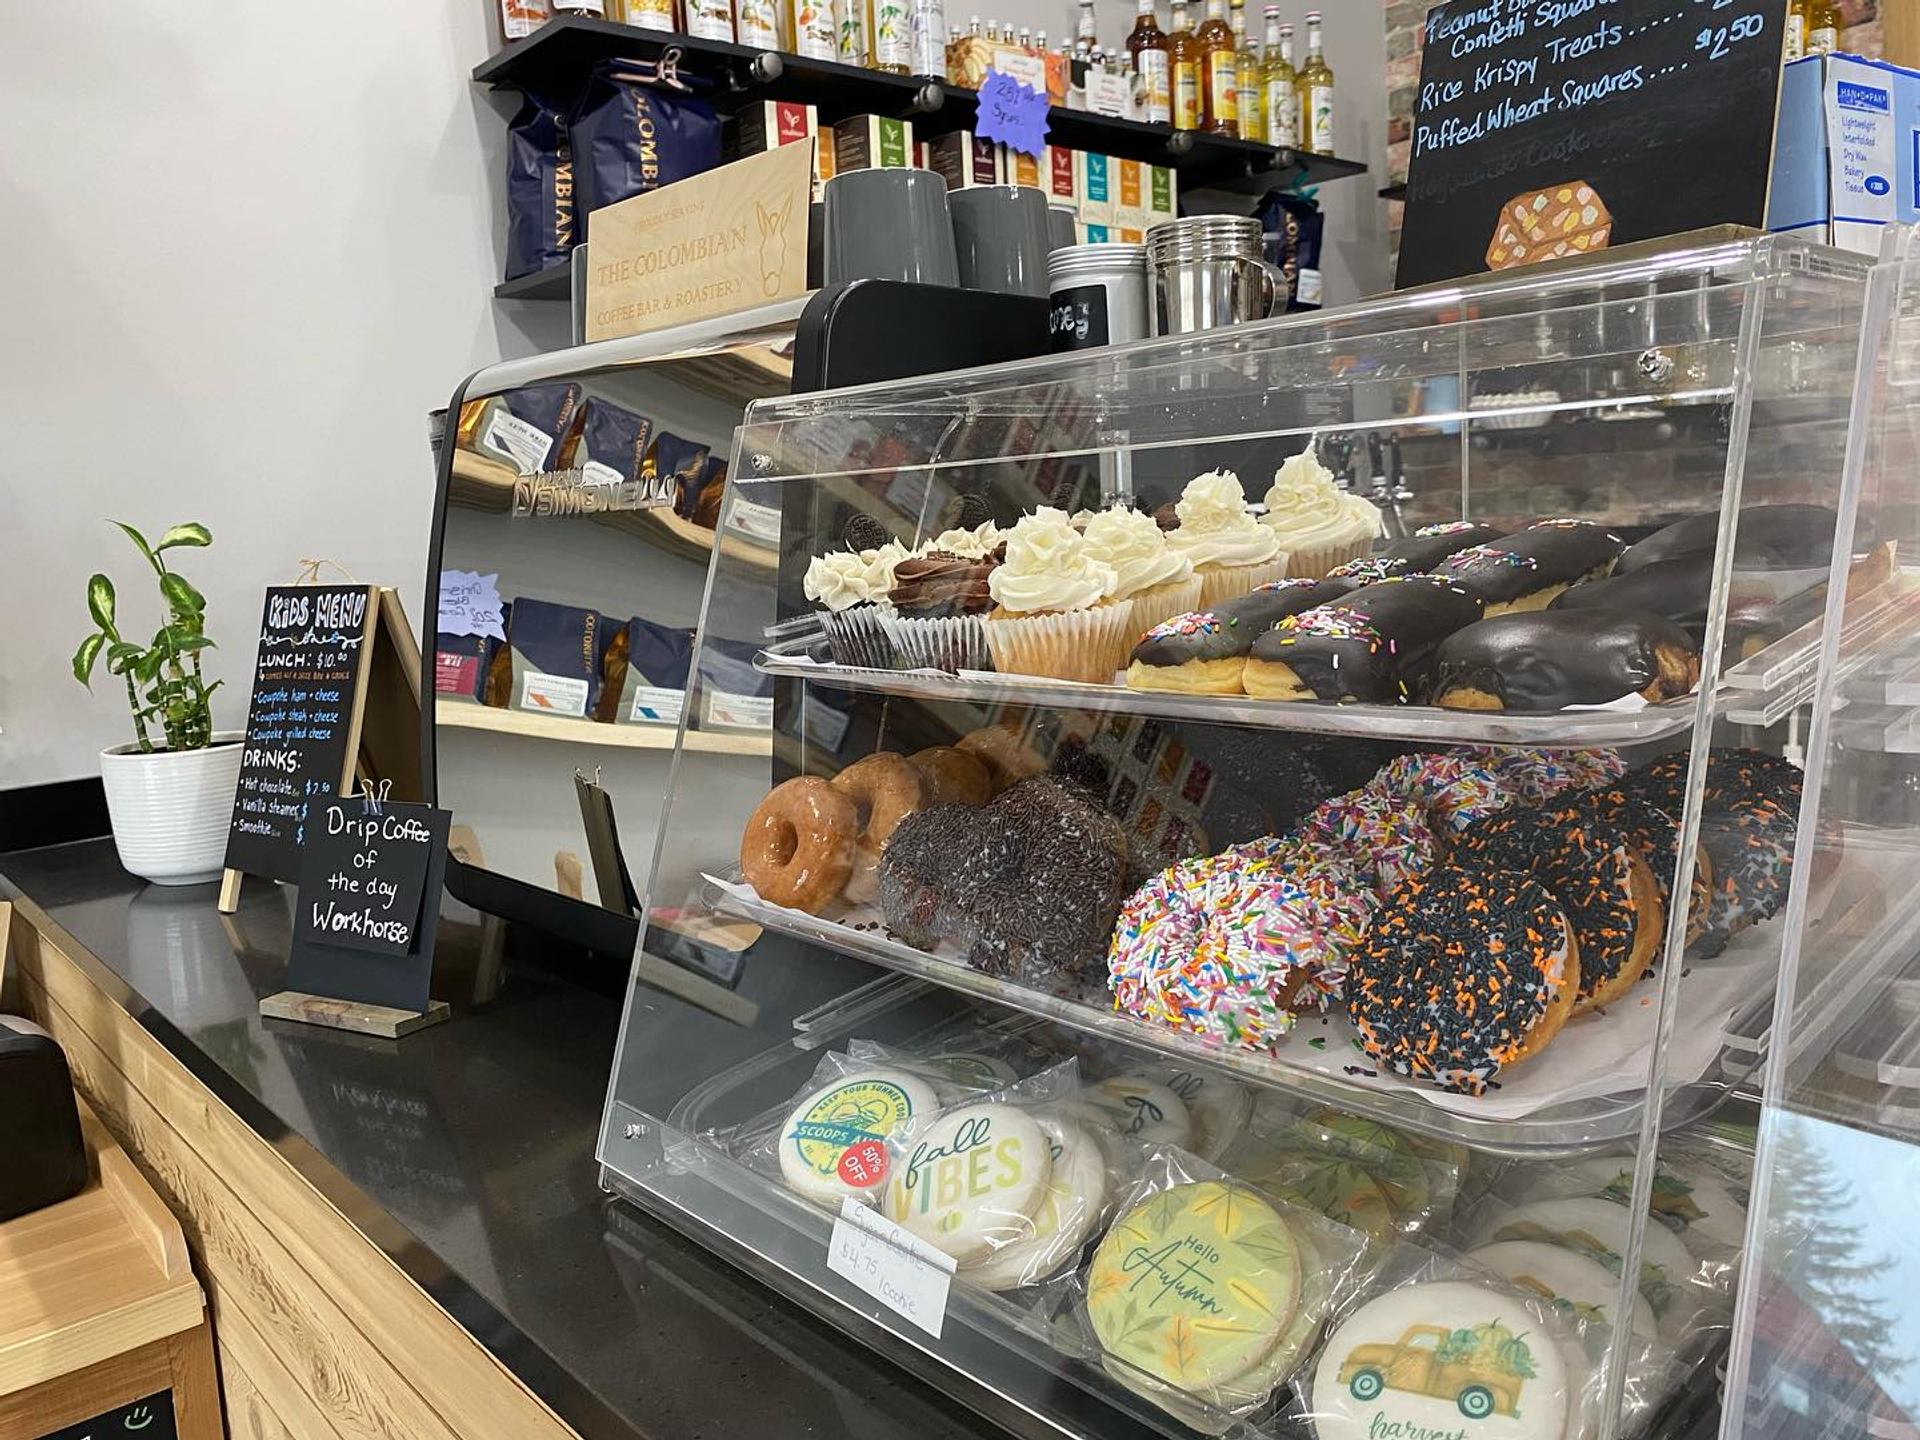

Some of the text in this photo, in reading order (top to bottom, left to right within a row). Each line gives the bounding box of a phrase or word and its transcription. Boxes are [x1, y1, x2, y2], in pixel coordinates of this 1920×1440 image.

[1452, 0, 1617, 58] Confetti Squa
[1420, 80, 1464, 112] Rice
[1473, 56, 1539, 93] Krispy
[1545, 20, 1622, 64] Treats
[1416, 112, 1485, 157] Puffed
[1487, 87, 1555, 130] Wheat
[1558, 66, 1643, 109] Squares
[598, 225, 747, 287] THE COLOMBIAN
[597, 278, 744, 326] COFFEE BAR & ROASTERY
[258, 653, 312, 667] LUNCH:
[315, 688, 339, 702] cheese
[314, 709, 339, 723] cheese
[308, 727, 331, 739] cheese
[245, 777, 259, 790] Hot
[259, 777, 292, 795] chocolate
[242, 798, 266, 813] Vanilla
[239, 819, 271, 835] Smoothie
[326, 805, 431, 847] Drip Coffee
[353, 849, 378, 869] of
[327, 872, 398, 910] the day
[312, 901, 410, 945] Workhorse
[843, 1084, 868, 1096] YOUR
[798, 1125, 849, 1142] SCOOPS
[862, 1146, 884, 1173] 50%
[906, 1117, 992, 1190] fall
[844, 1156, 868, 1182] OFF
[894, 1137, 1022, 1222] VIBES
[1183, 1235, 1220, 1264] Hello
[1122, 1240, 1223, 1314] Autumn
